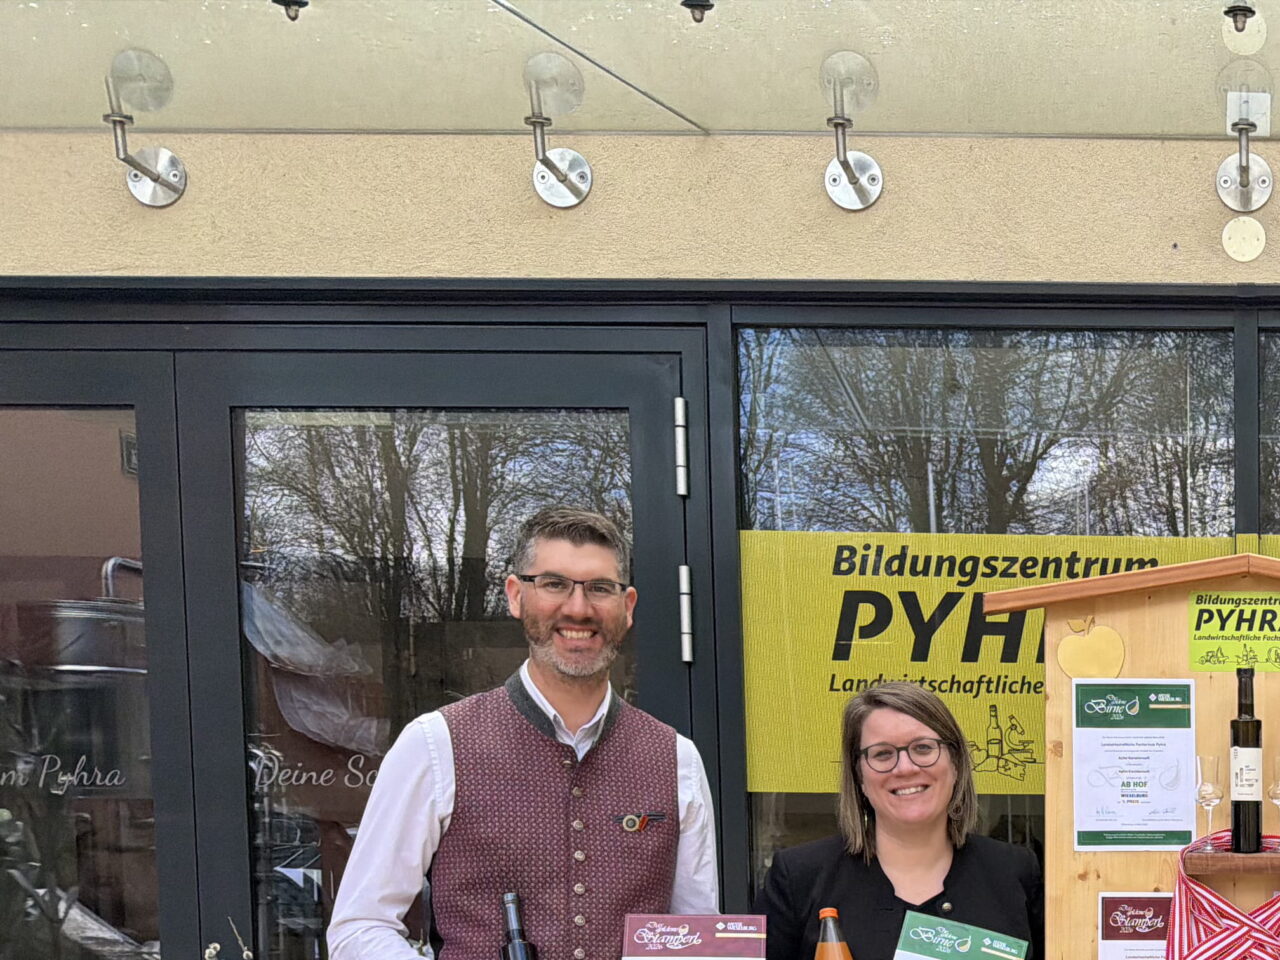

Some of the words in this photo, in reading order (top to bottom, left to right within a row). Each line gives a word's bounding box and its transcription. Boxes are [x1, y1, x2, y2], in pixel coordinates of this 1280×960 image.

[1193, 634, 1261, 642] Landwirtschaftliche
[1084, 699, 1124, 713] Birne
[38, 754, 126, 795] Pyhra
[254, 754, 336, 791] Deine
[1110, 912, 1164, 929] Stamperl
[634, 928, 702, 947] Stamperl
[910, 926, 954, 947] Birne
